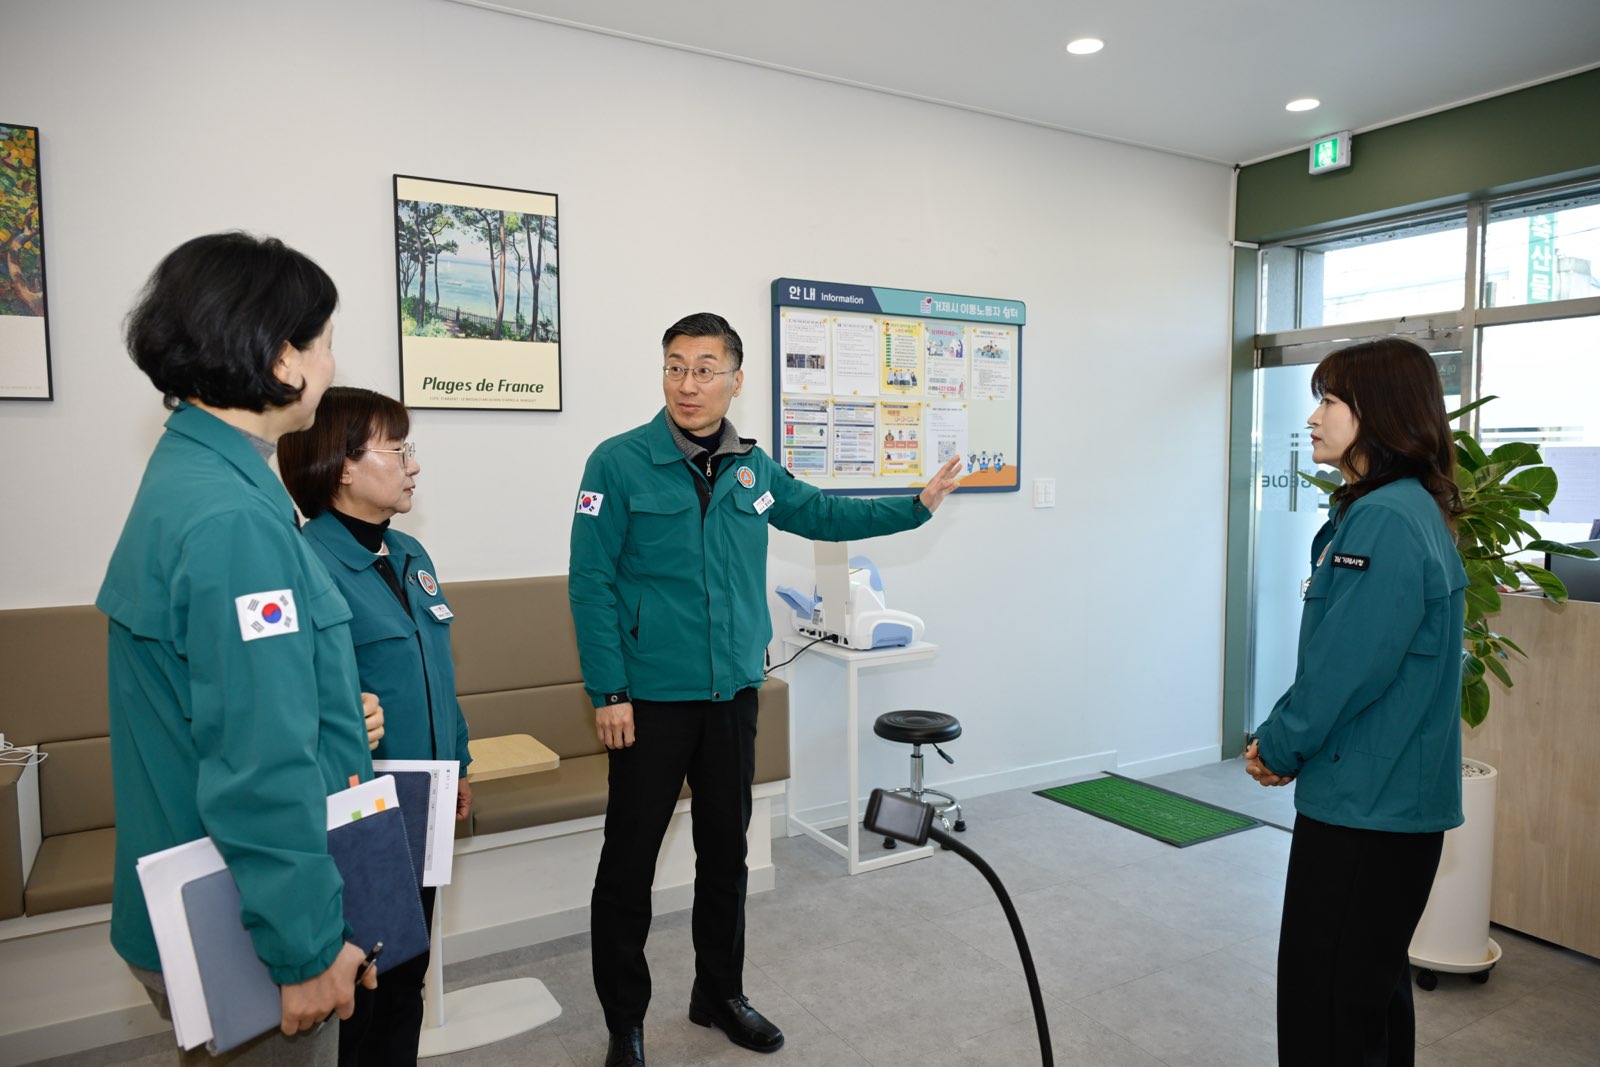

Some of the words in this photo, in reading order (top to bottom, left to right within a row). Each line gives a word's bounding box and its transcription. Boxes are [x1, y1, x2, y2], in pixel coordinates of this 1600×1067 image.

[821, 292, 864, 304] Information
[934, 301, 959, 313] 거제시
[960, 303, 1001, 317] 이동노동자
[1002, 306, 1018, 319] 쉼터
[422, 376, 472, 394] Plages
[476, 378, 494, 392] de
[498, 379, 544, 393] France
